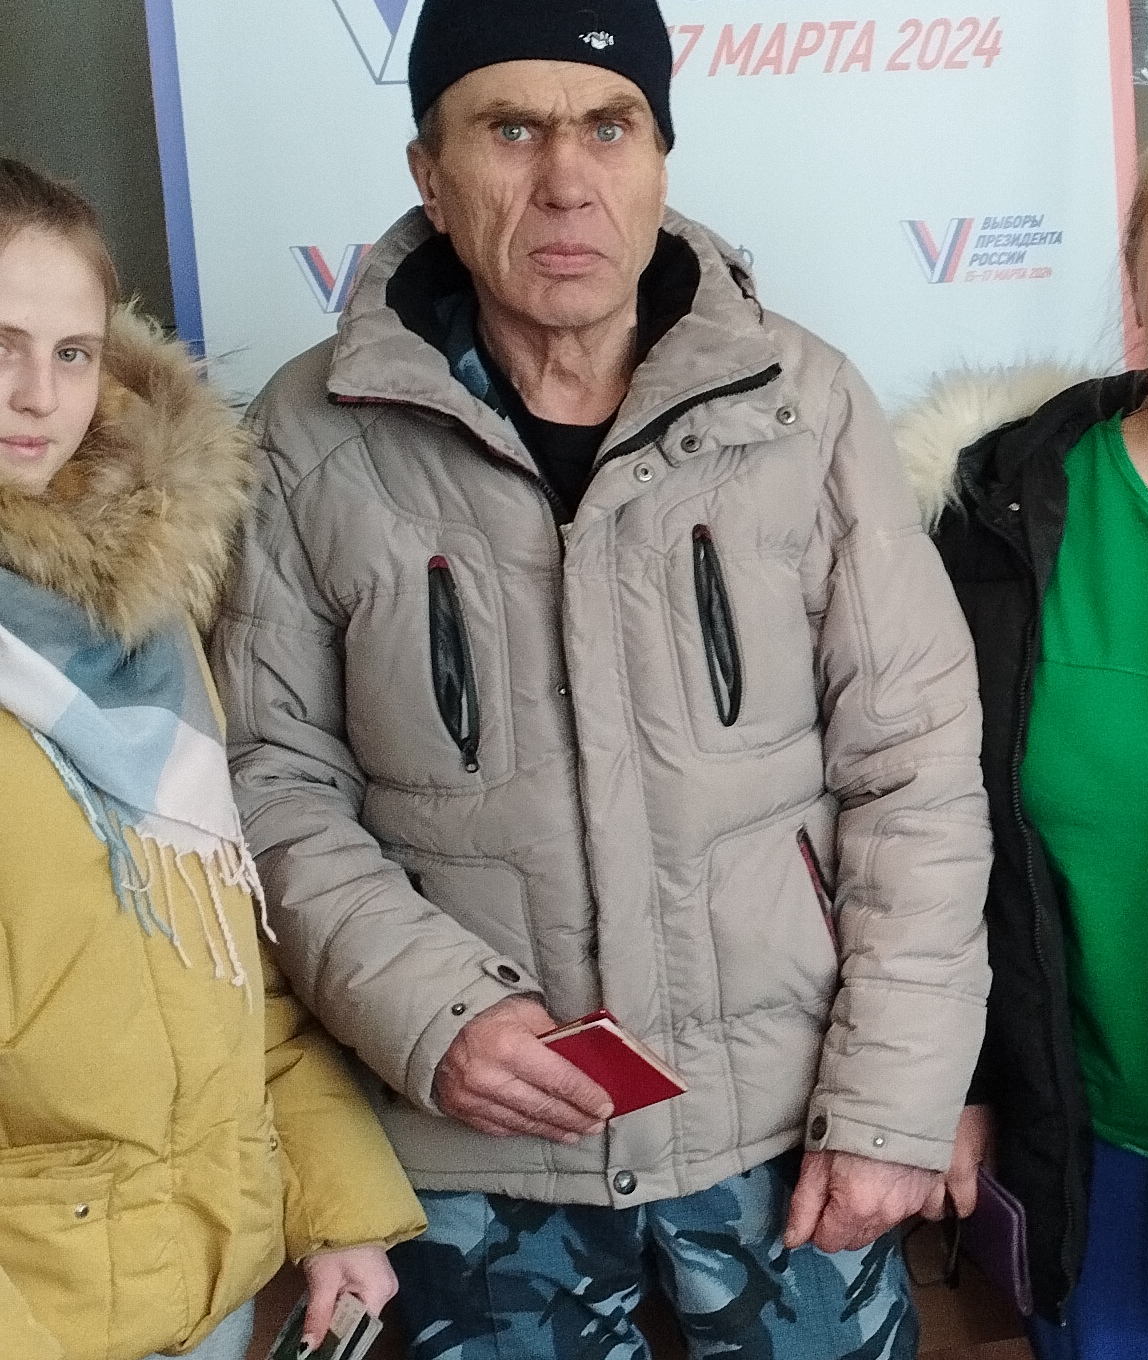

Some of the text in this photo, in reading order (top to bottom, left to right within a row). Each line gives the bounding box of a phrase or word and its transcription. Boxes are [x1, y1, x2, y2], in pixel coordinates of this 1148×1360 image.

[707, 19, 877, 78] МАРТА
[884, 15, 1003, 72] 2024
[981, 214, 1044, 230] ВЫБОРЫ
[974, 231, 1063, 248] ПРЕЗИДЕНТА
[968, 250, 1027, 266] РОССИИ
